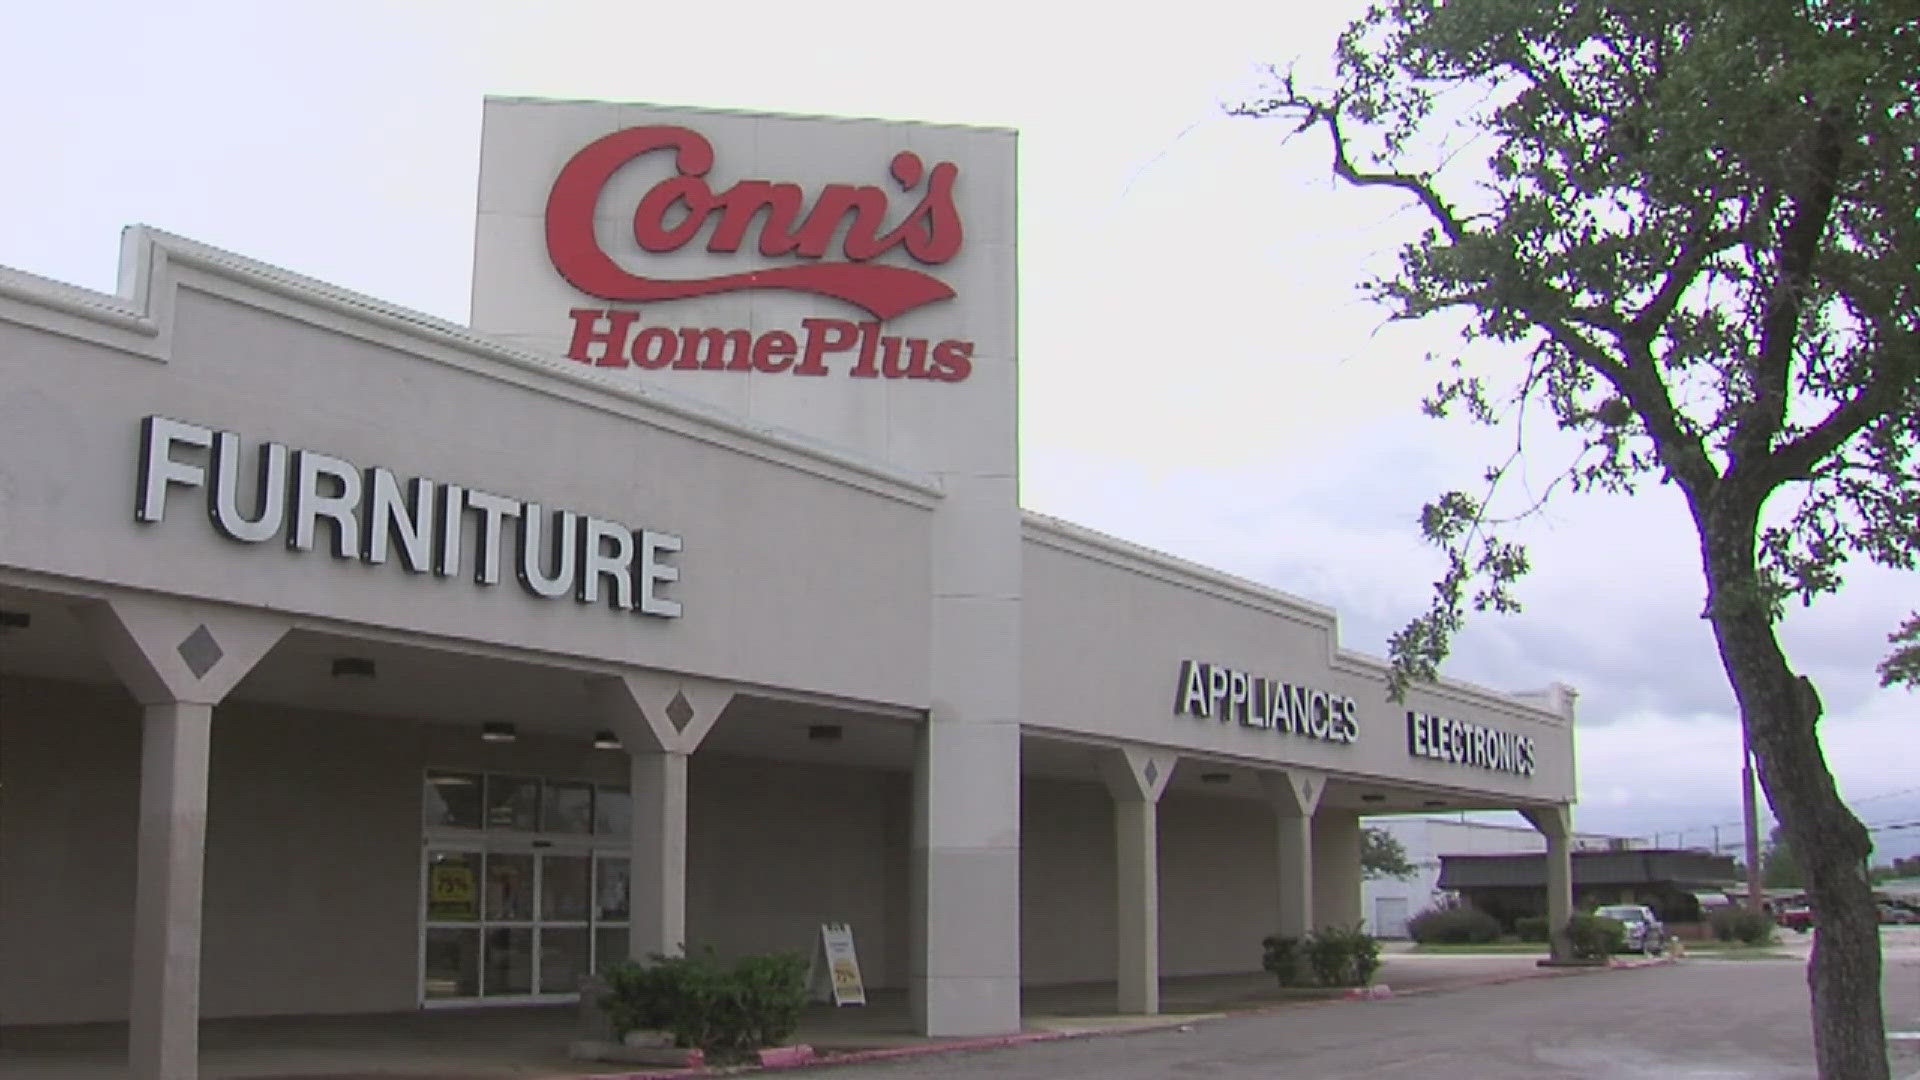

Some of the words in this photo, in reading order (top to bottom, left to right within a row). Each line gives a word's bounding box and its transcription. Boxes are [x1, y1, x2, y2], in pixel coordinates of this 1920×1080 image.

[546, 125, 963, 320] Conn's
[567, 308, 975, 382] HomePlus
[136, 414, 682, 618] FURNITURE
[1176, 660, 1360, 744] APPLIANCES
[1407, 711, 1536, 776] ELECTRONICS
